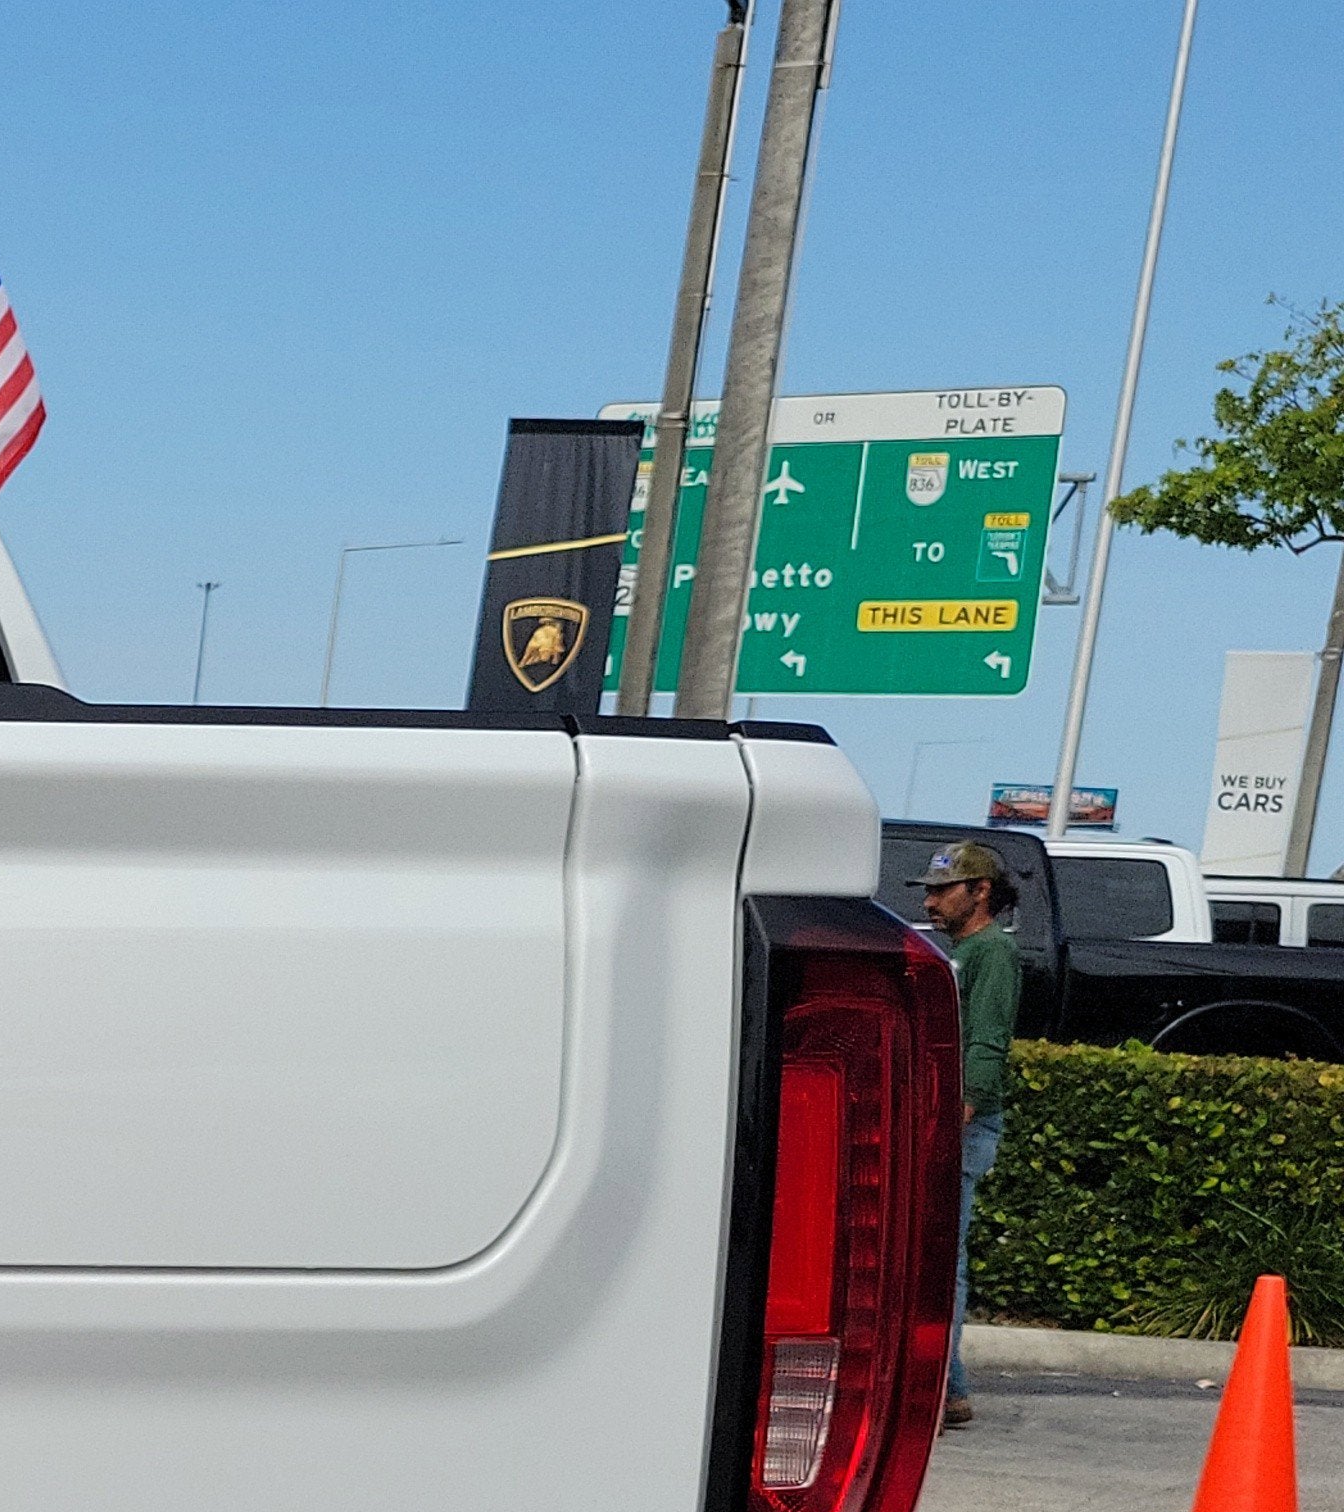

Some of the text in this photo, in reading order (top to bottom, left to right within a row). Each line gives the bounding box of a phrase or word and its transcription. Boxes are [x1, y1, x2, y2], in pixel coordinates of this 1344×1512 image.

[813, 412, 836, 425] OR
[944, 417, 1016, 434] PLATE
[958, 459, 1020, 480] WEST
[912, 541, 945, 562] TO
[868, 607, 1010, 625] THIS LANE
[1220, 774, 1287, 790] WE BUY
[1217, 791, 1284, 813] CARS
